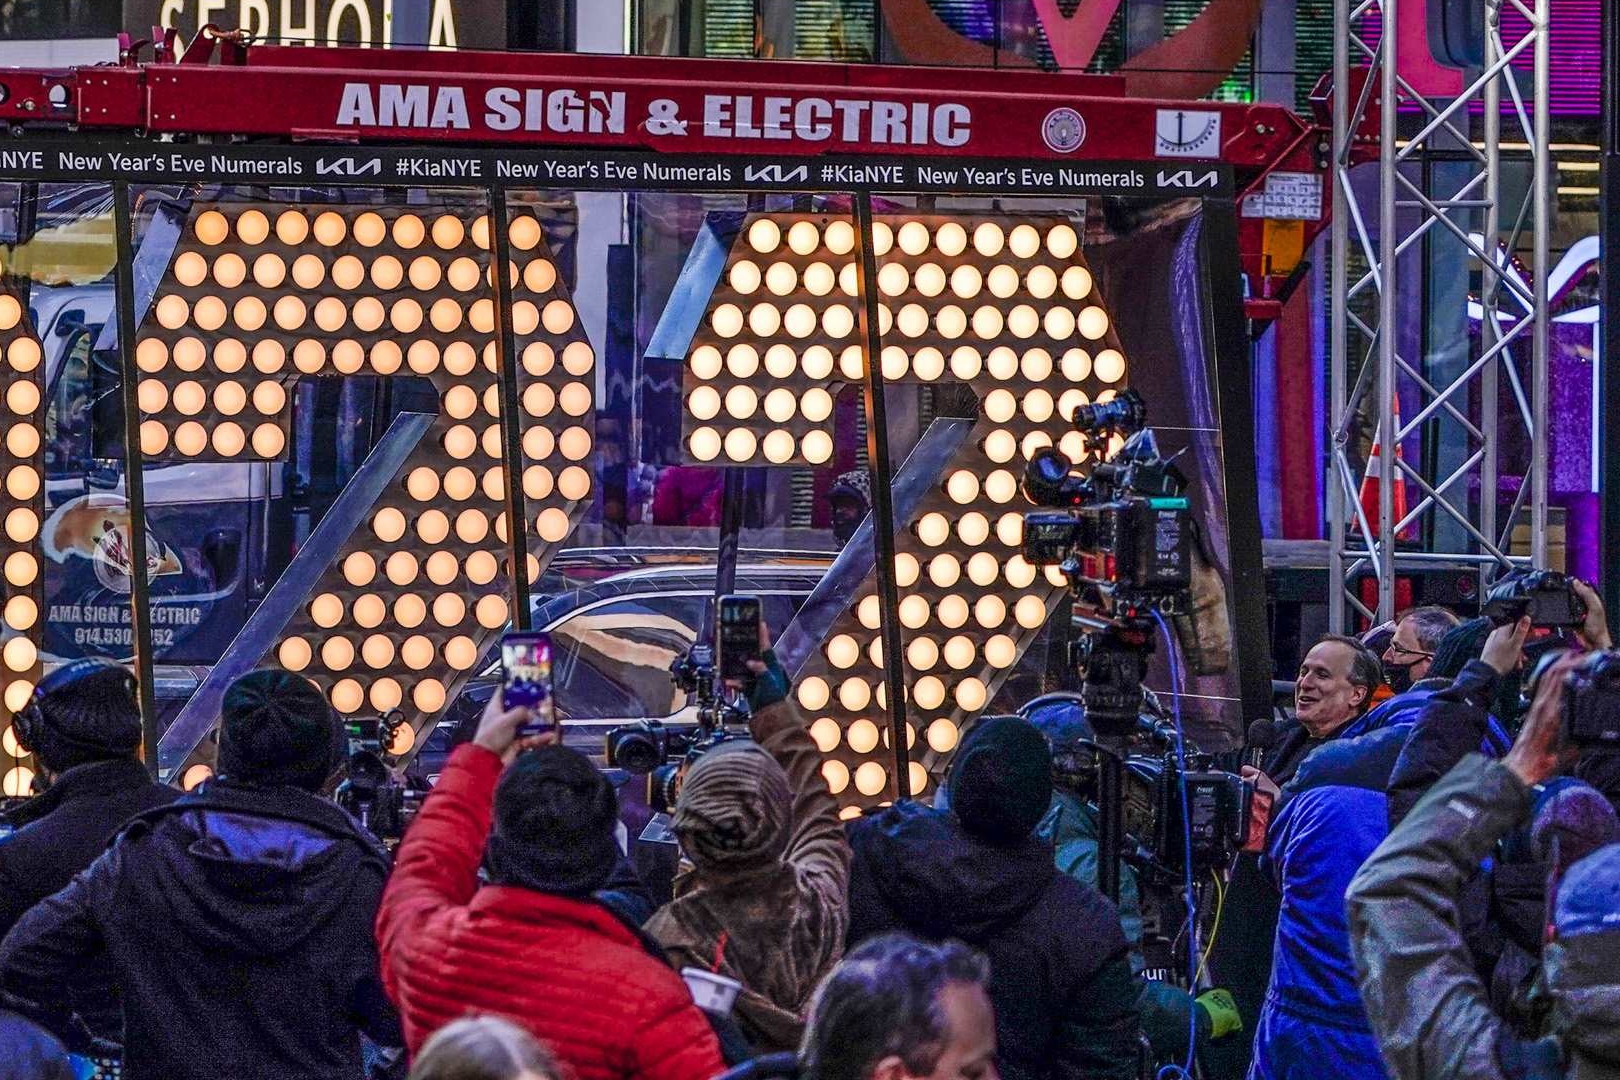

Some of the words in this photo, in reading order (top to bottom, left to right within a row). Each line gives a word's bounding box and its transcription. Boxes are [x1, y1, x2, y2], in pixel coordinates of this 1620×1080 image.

[336, 82, 471, 129] AMA
[484, 86, 626, 134] SIGN
[645, 99, 688, 136] &
[703, 94, 972, 147] ELECTRIC
[60, 152, 102, 170] New
[107, 152, 165, 172] Year's
[171, 154, 206, 172] Eve
[211, 155, 303, 174] Numerals
[396, 158, 482, 177] #KiaNYE
[497, 160, 538, 177] New
[543, 160, 599, 179] Year's
[605, 161, 638, 179] Eve
[643, 163, 732, 182] Numerals
[821, 165, 904, 184] #KiaNYE
[918, 166, 956, 185] New
[962, 166, 1016, 186] Year's
[1022, 168, 1054, 186] Eve
[1059, 168, 1145, 187] Numerals
[48, 605, 80, 623] AMA
[83, 606, 119, 624] SIGN
[149, 607, 201, 625] ECTRIC
[74, 628, 174, 646] 914.53052
